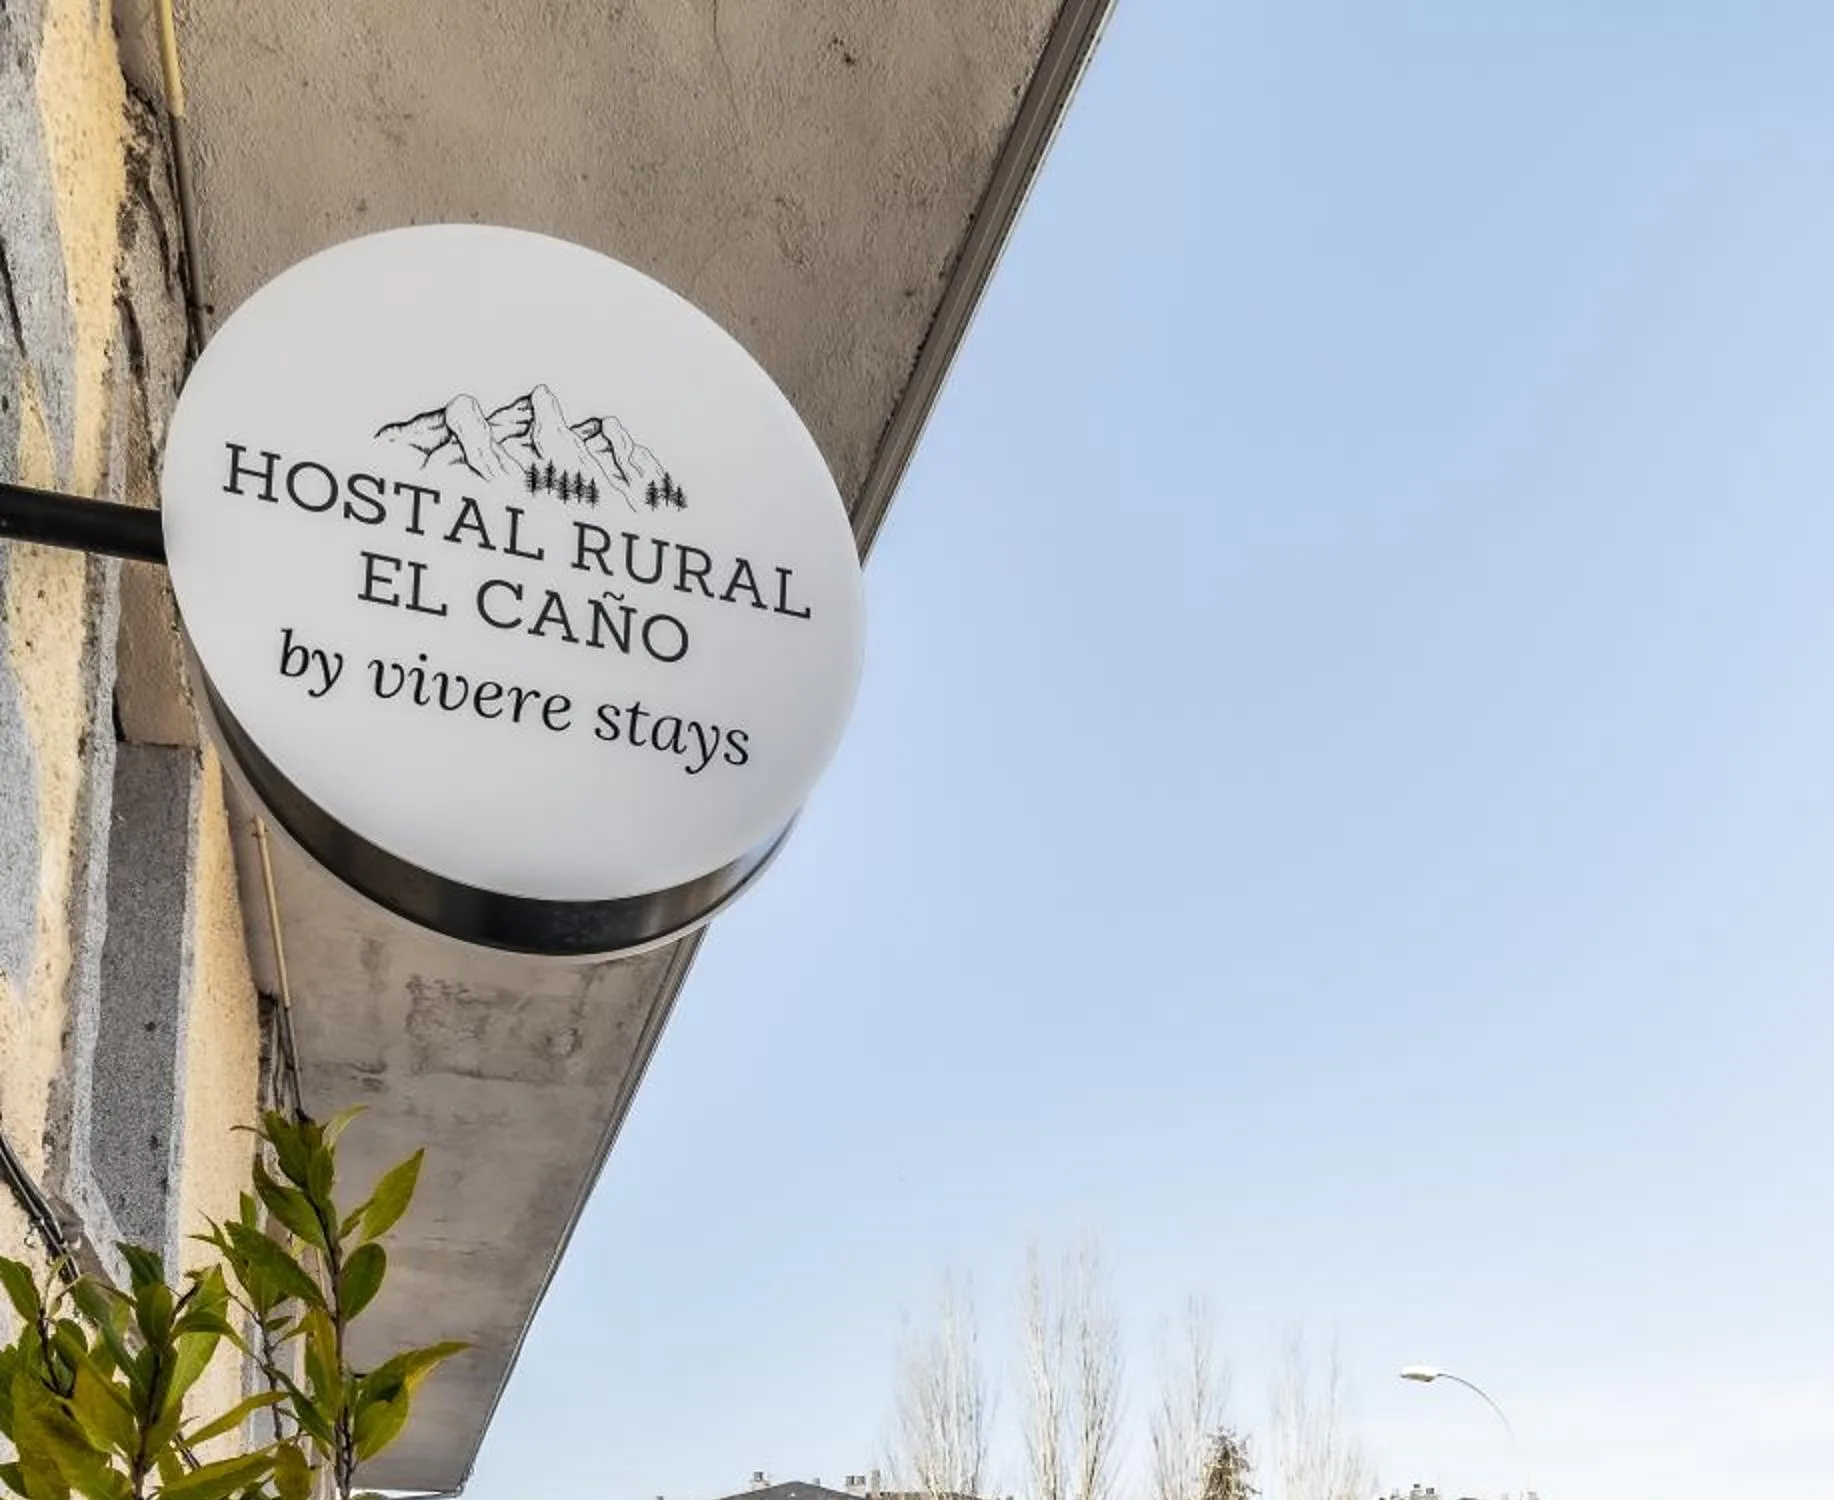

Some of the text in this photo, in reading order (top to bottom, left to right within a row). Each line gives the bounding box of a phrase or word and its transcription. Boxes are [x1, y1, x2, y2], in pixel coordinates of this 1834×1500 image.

[223, 442, 812, 620] HOSTAL RURAL
[357, 551, 689, 663] EL CAÑO
[279, 628, 751, 775] by vivere stays
